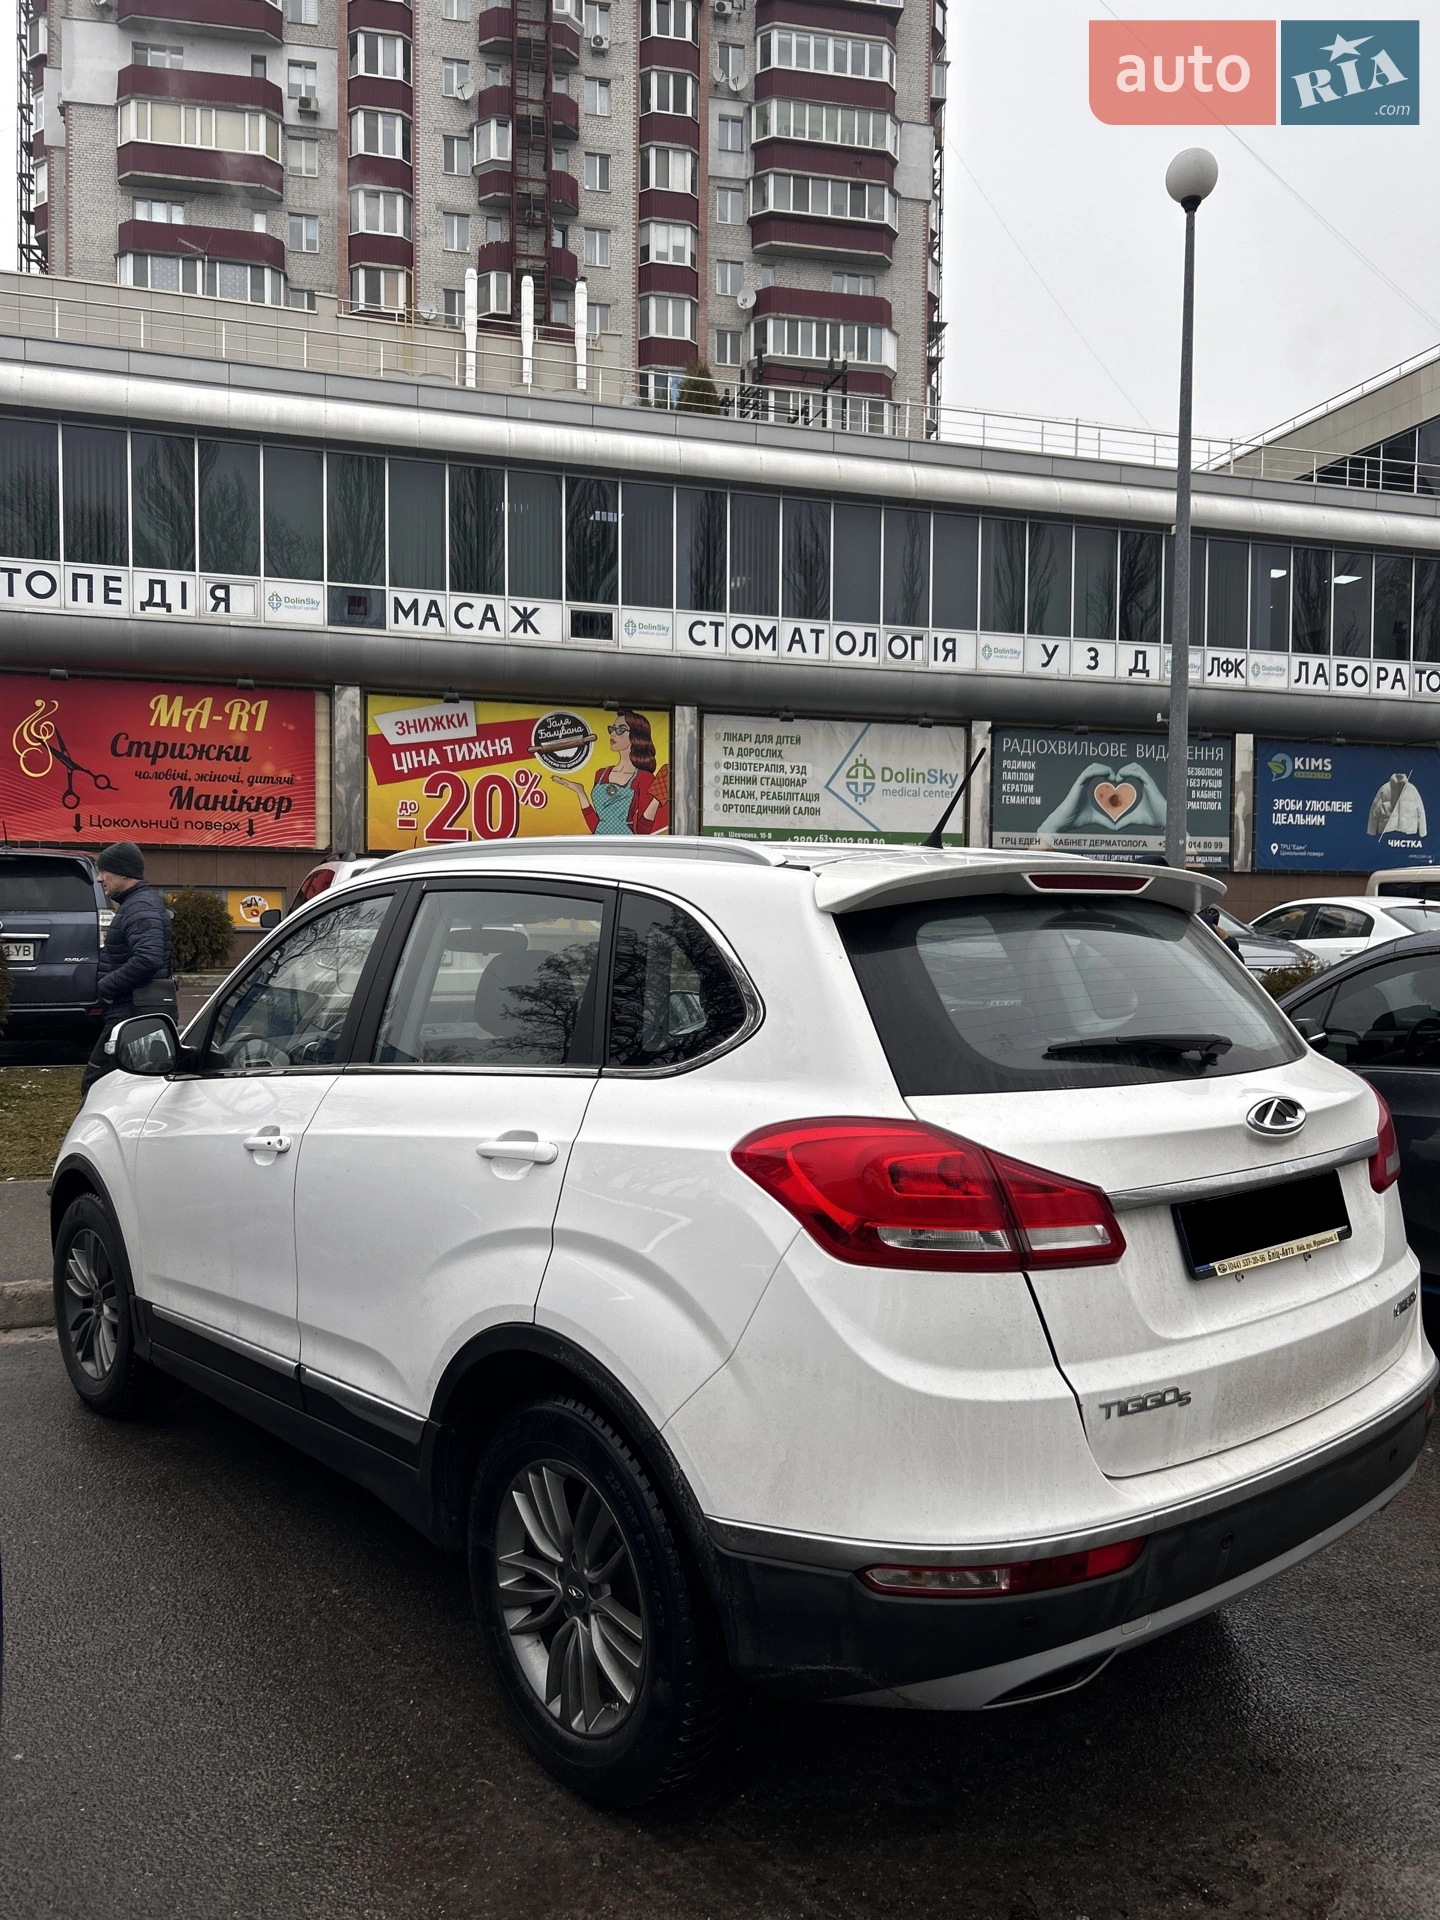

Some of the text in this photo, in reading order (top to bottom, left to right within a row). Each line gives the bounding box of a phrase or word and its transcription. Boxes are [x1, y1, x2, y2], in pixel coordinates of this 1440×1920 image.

[0, 567, 231, 613] ТОПЕДІЯ
[284, 596, 320, 607] DolinSky
[393, 596, 541, 635] МАСАЖ
[638, 622, 670, 633] DolinSky
[688, 620, 956, 663] СТОМАТОЛОГІЯ
[1207, 656, 1245, 679] ЛФК
[1294, 661, 1440, 693] ЛАБОРАТО
[394, 712, 469, 737] ЗНИЖКИ
[546, 716, 571, 729] Галя
[538, 726, 584, 739] Балувана
[722, 732, 801, 746] ЛІКАРІ ДЛЯ ДІТЕЙ
[110, 732, 252, 766] Стрижки
[391, 737, 514, 774] ЦІНА ТИЖНЯ
[722, 746, 783, 759] ТА ДОРОСЛИХ
[1003, 737, 1224, 762] РАДІОХВИЛЬОВЕ ВИДЕННЯ
[723, 761, 807, 776] ФІЗІОТЕРАПІЯ, УЗД
[1002, 759, 1036, 770] РОДИМОК
[1294, 756, 1332, 771] KIMS
[134, 768, 295, 787] чоловічі, жіночі, дитячі
[881, 766, 959, 789] DolinSky
[1002, 771, 1034, 782] ПАПІЛОМ
[1187, 767, 1223, 777] БЕЗБОЛІСНО
[722, 775, 807, 788] ДЕННИЙ СТАЦІОНАР
[1002, 783, 1034, 793] КЕРАТОМ
[1189, 779, 1200, 787] БЕЗ
[1201, 779, 1222, 789] РУБЦІВ
[722, 789, 820, 803] МАСАЖ, РЕАБІЛІТАЦІЯ
[882, 786, 955, 799] medical center
[1191, 790, 1222, 799] В КАБІНЕТІ
[169, 785, 293, 820] Манікюр
[1001, 795, 1042, 805] ГЕМАНГІОМ
[1273, 798, 1353, 813] ЗРОБИ УЛЮБЛЕНЕ
[722, 803, 821, 816] ОРТОПЕДИЧНИЙ САЛОН
[89, 814, 241, 833] Цокольний поверх
[1272, 812, 1325, 826] ІДЕАЛЬНИМ
[1000, 837, 1016, 846] ТРЦ
[1018, 837, 1041, 846] ЕДЕН
[1053, 838, 1087, 847] КАБІНЕТ
[1088, 839, 1148, 848] ДЕРМАТОЛОГА
[1203, 841, 1212, 849] 80
[1387, 839, 1423, 848] ЧИСТКА
[1267, 1246, 1294, 1261] Бліц-Авто
